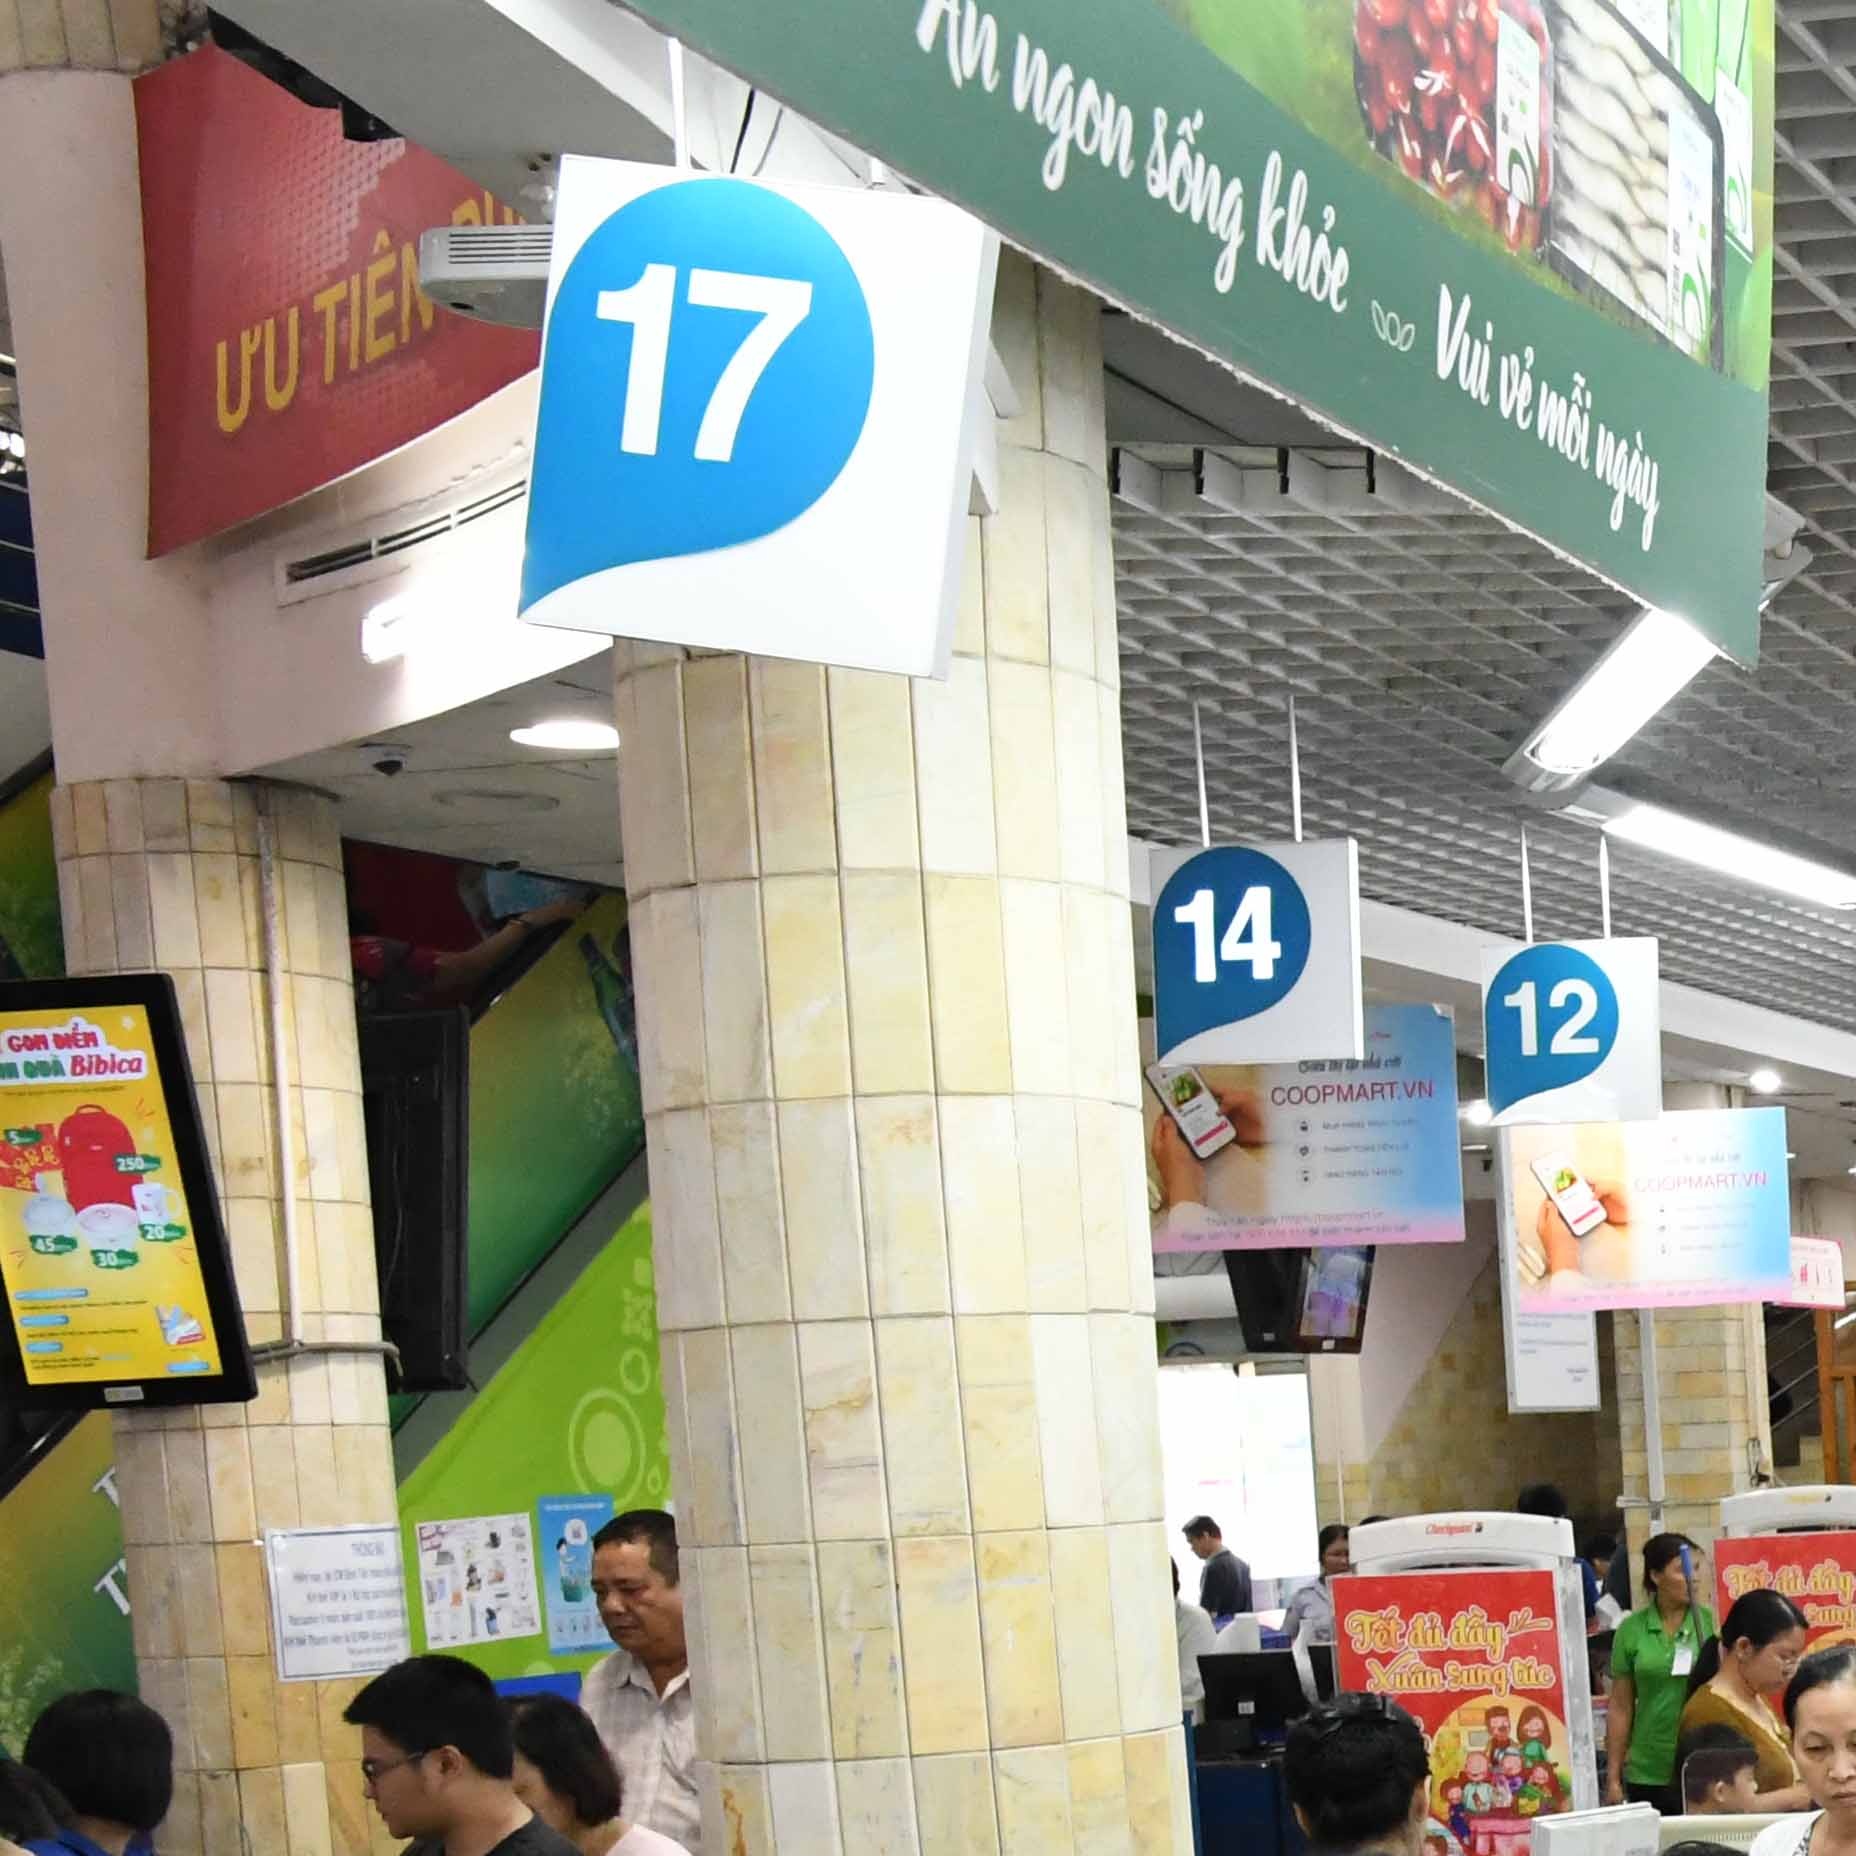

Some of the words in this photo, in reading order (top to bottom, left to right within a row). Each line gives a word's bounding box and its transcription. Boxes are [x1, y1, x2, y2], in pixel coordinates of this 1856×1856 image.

[1012, 34, 1135, 191] ngon
[1145, 104, 1244, 293] sống
[1256, 150, 1349, 313] khỏe
[215, 309, 300, 433] ƯU
[596, 262, 812, 463] 17
[1436, 284, 1492, 407] Vui
[1500, 345, 1535, 434] vẻ
[1537, 373, 1592, 469] mỗi
[1598, 422, 1660, 550] ngày
[1174, 886, 1282, 983] 14
[1504, 977, 1600, 1057] 12
[70, 1053, 143, 1077] Bibica
[1270, 1079, 1433, 1107] COOPMART.VN
[117, 1157, 145, 1172] 250
[98, 1252, 117, 1267] 30
[146, 1226, 165, 1239] 20
[1345, 1606, 1405, 1654] Tết
[1408, 1611, 1446, 1651] đủ
[1450, 1604, 1507, 1662] đầy
[1367, 1650, 1445, 1692] Xuân
